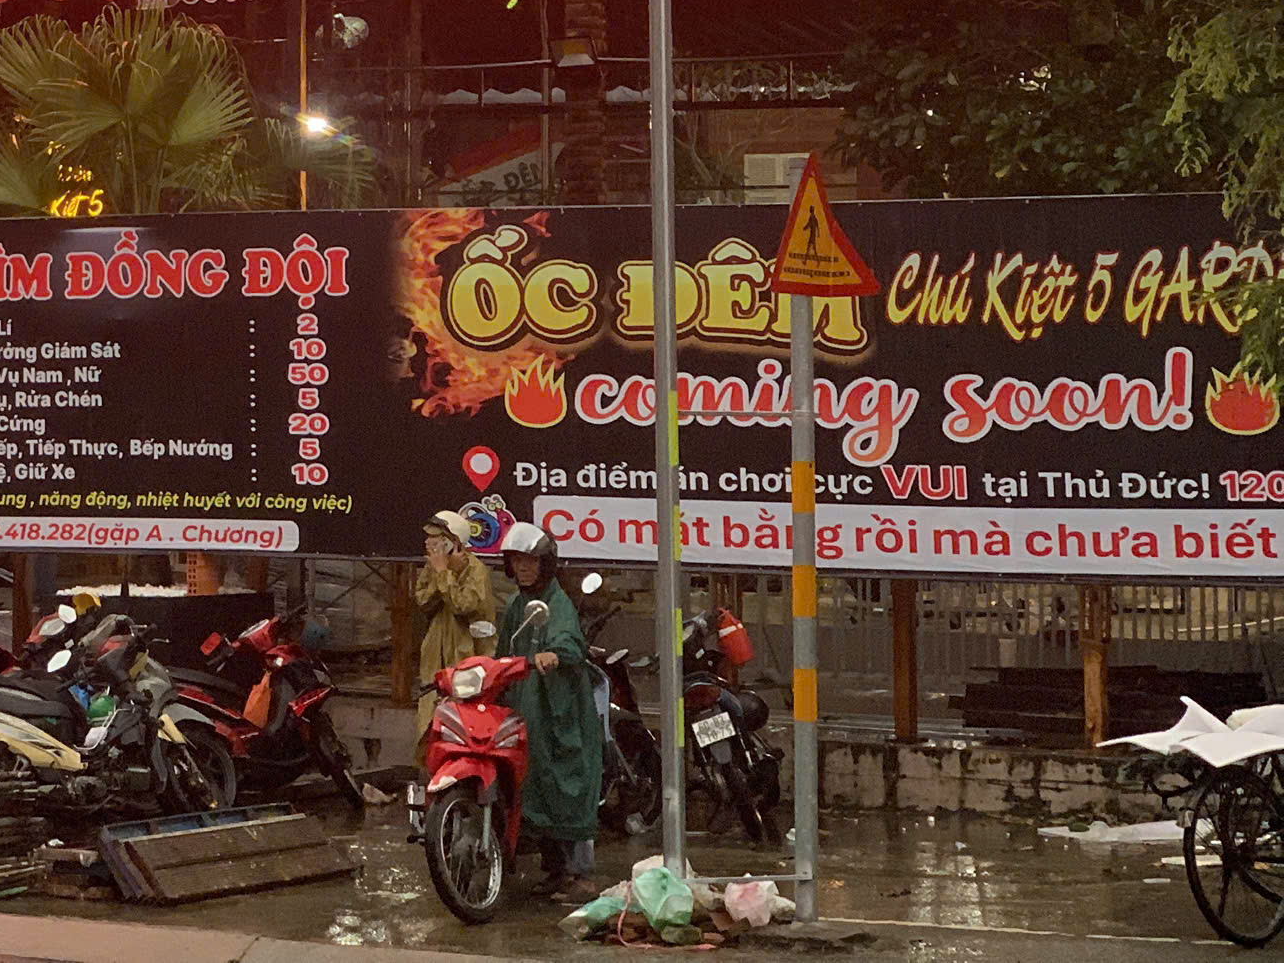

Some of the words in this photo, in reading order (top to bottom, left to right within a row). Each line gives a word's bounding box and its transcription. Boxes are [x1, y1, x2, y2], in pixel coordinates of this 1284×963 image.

[88, 189, 104, 217] 5
[64, 230, 229, 299] ĐỒNG
[242, 233, 349, 309] ĐỘI
[447, 225, 598, 346] ỐC
[886, 252, 976, 325] Chú
[983, 252, 1078, 341] Kiệt
[1084, 252, 1120, 324] 5
[1124, 239, 1284, 338] GARD
[297, 313, 318, 335] 2
[41, 341, 87, 359] Giám
[90, 341, 121, 359] Sát
[289, 338, 326, 360] 10
[74, 366, 102, 383] Nữ
[288, 363, 329, 385] 50
[15, 389, 51, 407] Rửa
[54, 389, 103, 407] Chén
[298, 388, 319, 410] 5
[574, 358, 919, 467] coming
[942, 347, 1194, 443] soon!
[288, 413, 329, 435] 20
[26, 438, 66, 459] Tiếp
[69, 439, 124, 460] Thực,
[129, 438, 165, 460] Bếp
[169, 439, 233, 461] Nướng
[299, 438, 321, 460] 5
[15, 462, 49, 480] Giữ
[51, 463, 76, 480] Xe
[291, 463, 329, 485] 10
[513, 462, 567, 495] Địa
[576, 462, 657, 490] điểm
[718, 467, 792, 493] chơi
[814, 470, 874, 500] cực
[880, 464, 968, 501] VUI
[982, 472, 1029, 503] tại
[1038, 469, 1111, 499] Thủ
[1118, 473, 1210, 499] Đức!
[1219, 470, 1284, 502] 120
[39, 492, 81, 509] năng
[85, 491, 132, 510] động,
[136, 491, 179, 510] nhiệt
[183, 491, 231, 511] huyết
[236, 492, 261, 508] với
[265, 493, 308, 512] công
[312, 493, 353, 514] việc)
[182, 524, 283, 548] Chương)
[542, 508, 606, 543] Có
[855, 513, 918, 555] rồi
[933, 520, 1012, 556] mà
[1025, 523, 1159, 559] chưa
[1174, 517, 1279, 560] biết
